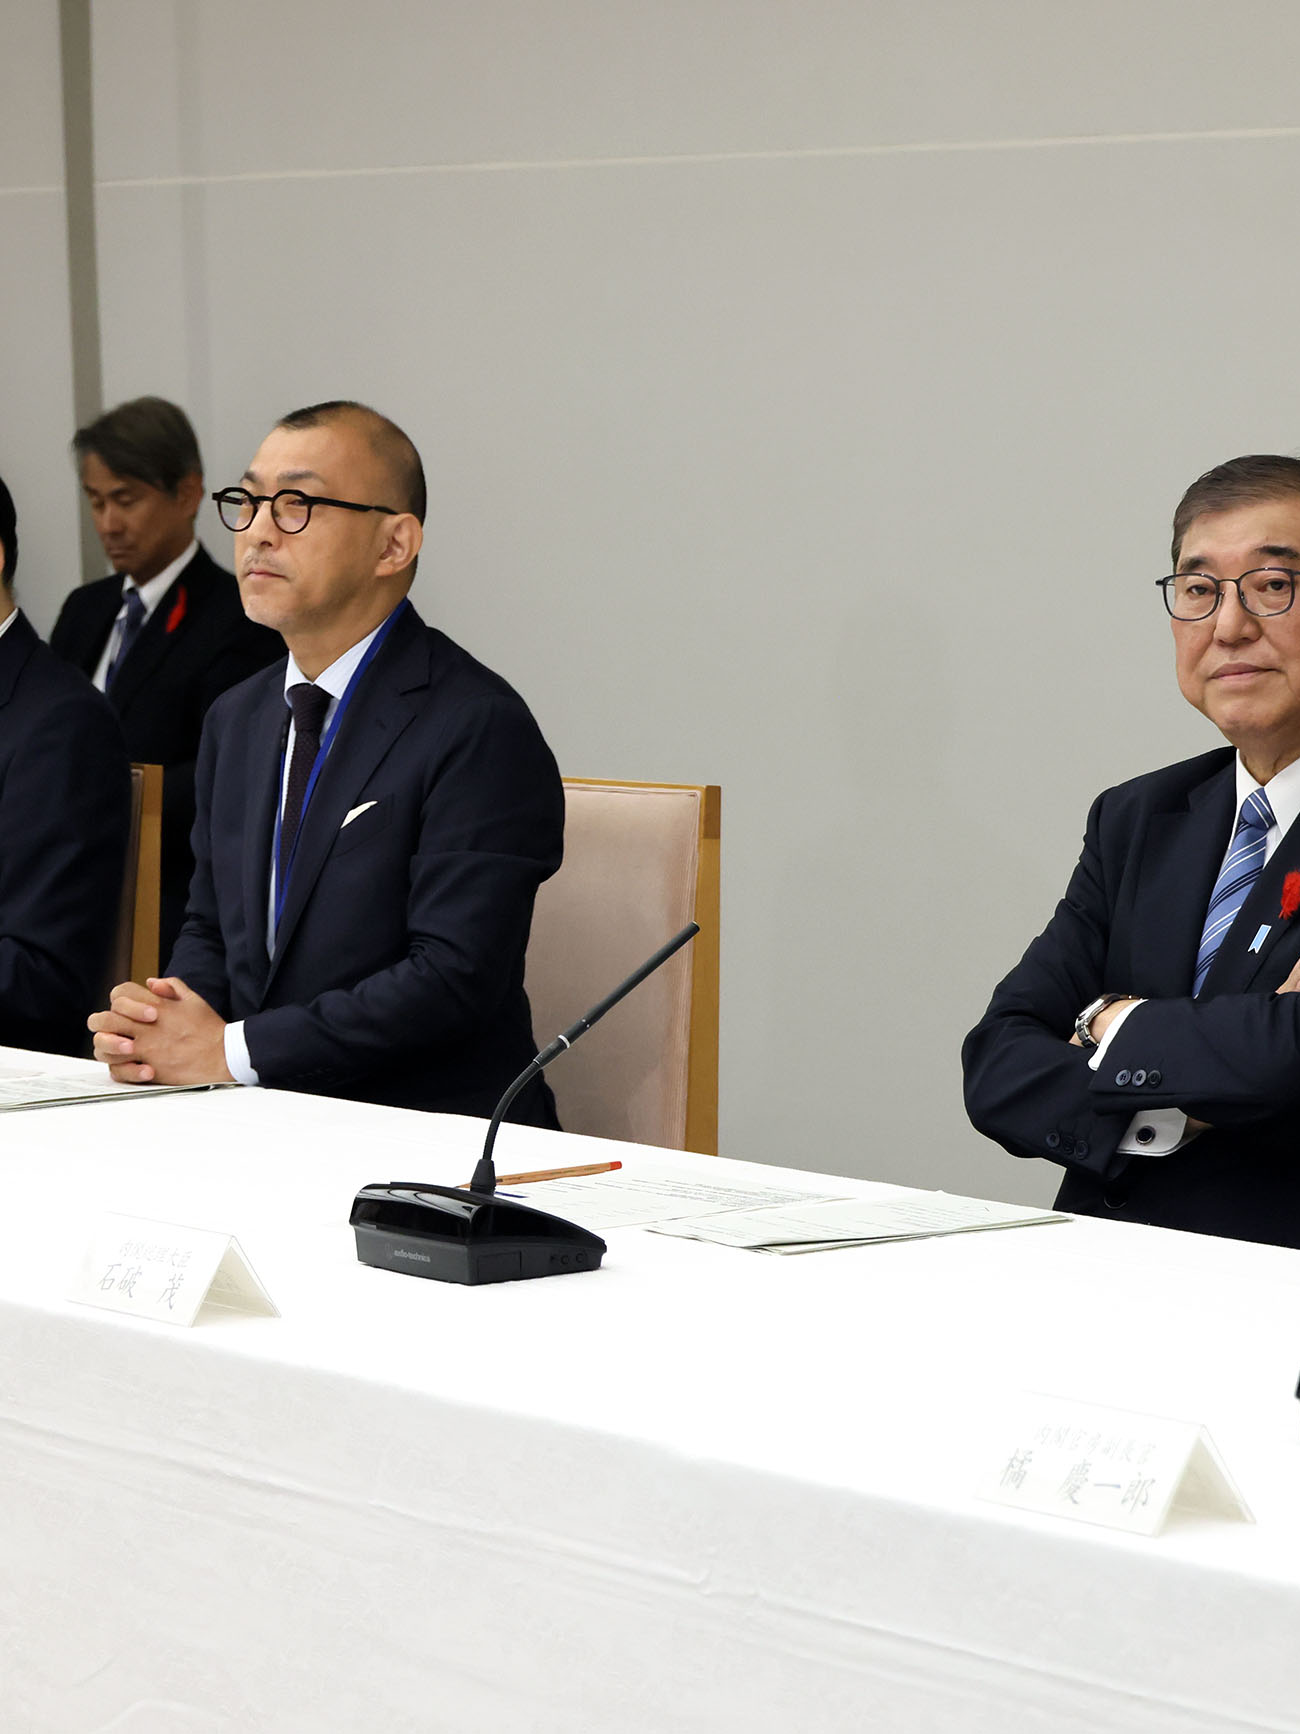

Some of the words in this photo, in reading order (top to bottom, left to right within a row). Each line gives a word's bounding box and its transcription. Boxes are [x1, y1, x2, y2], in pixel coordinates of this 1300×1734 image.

[96, 1263, 142, 1298] 石破
[1055, 1459, 1157, 1513] 慶一郎
